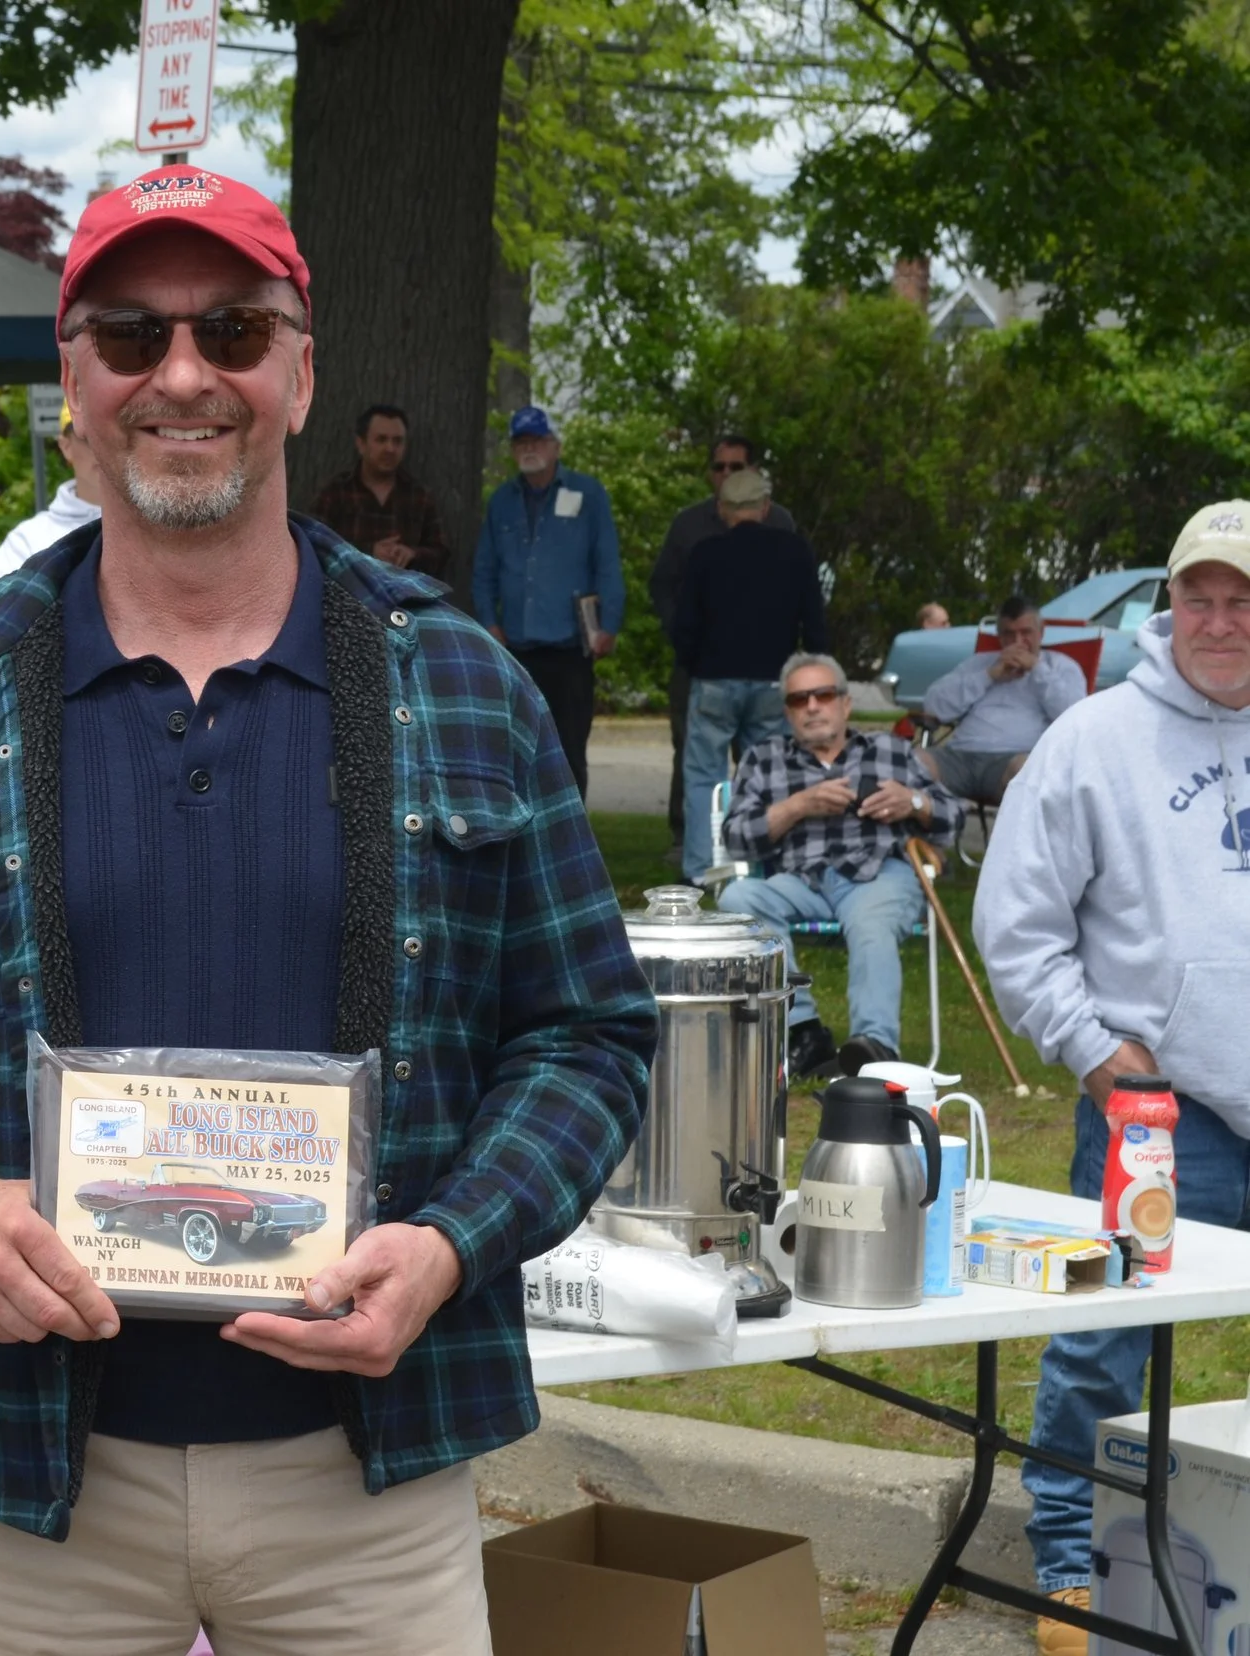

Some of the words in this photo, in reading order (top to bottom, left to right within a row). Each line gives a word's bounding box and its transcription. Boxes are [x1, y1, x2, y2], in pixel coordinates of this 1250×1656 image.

[147, 16, 211, 48] STOPPING
[161, 52, 192, 79] ANY
[159, 85, 190, 111] TIME
[131, 190, 214, 208] POLYTECHNIC
[137, 199, 207, 214] INSTITUTE
[1169, 762, 1232, 812] CLAM
[123, 1083, 178, 1098] 45th
[193, 1086, 290, 1104] ANNUAL
[79, 1103, 103, 1112] LONG
[105, 1105, 137, 1114] ISLAND
[168, 1101, 232, 1131] LONG
[236, 1105, 319, 1135] ISLAND
[86, 1144, 127, 1154] CHAPTER
[147, 1129, 190, 1155] ALL
[193, 1131, 266, 1161] BUICK
[269, 1136, 341, 1164] SHOW
[226, 1165, 261, 1180] MAY
[265, 1167, 288, 1182] 25,
[294, 1169, 331, 1184] 2025
[803, 1196, 854, 1219] MILK
[73, 1235, 142, 1250] WANTAGH
[97, 1249, 116, 1261] NY
[81, 1265, 101, 1281] OB
[106, 1266, 179, 1285] BRENNAN
[185, 1271, 269, 1290] MEMORIAL
[274, 1276, 313, 1292] AWA
[527, 1281, 541, 1301] 12
[554, 1279, 563, 1309] VASOS
[566, 1282, 574, 1307] CUPS
[574, 1282, 583, 1309] FOAM
[589, 1279, 600, 1316] DART
